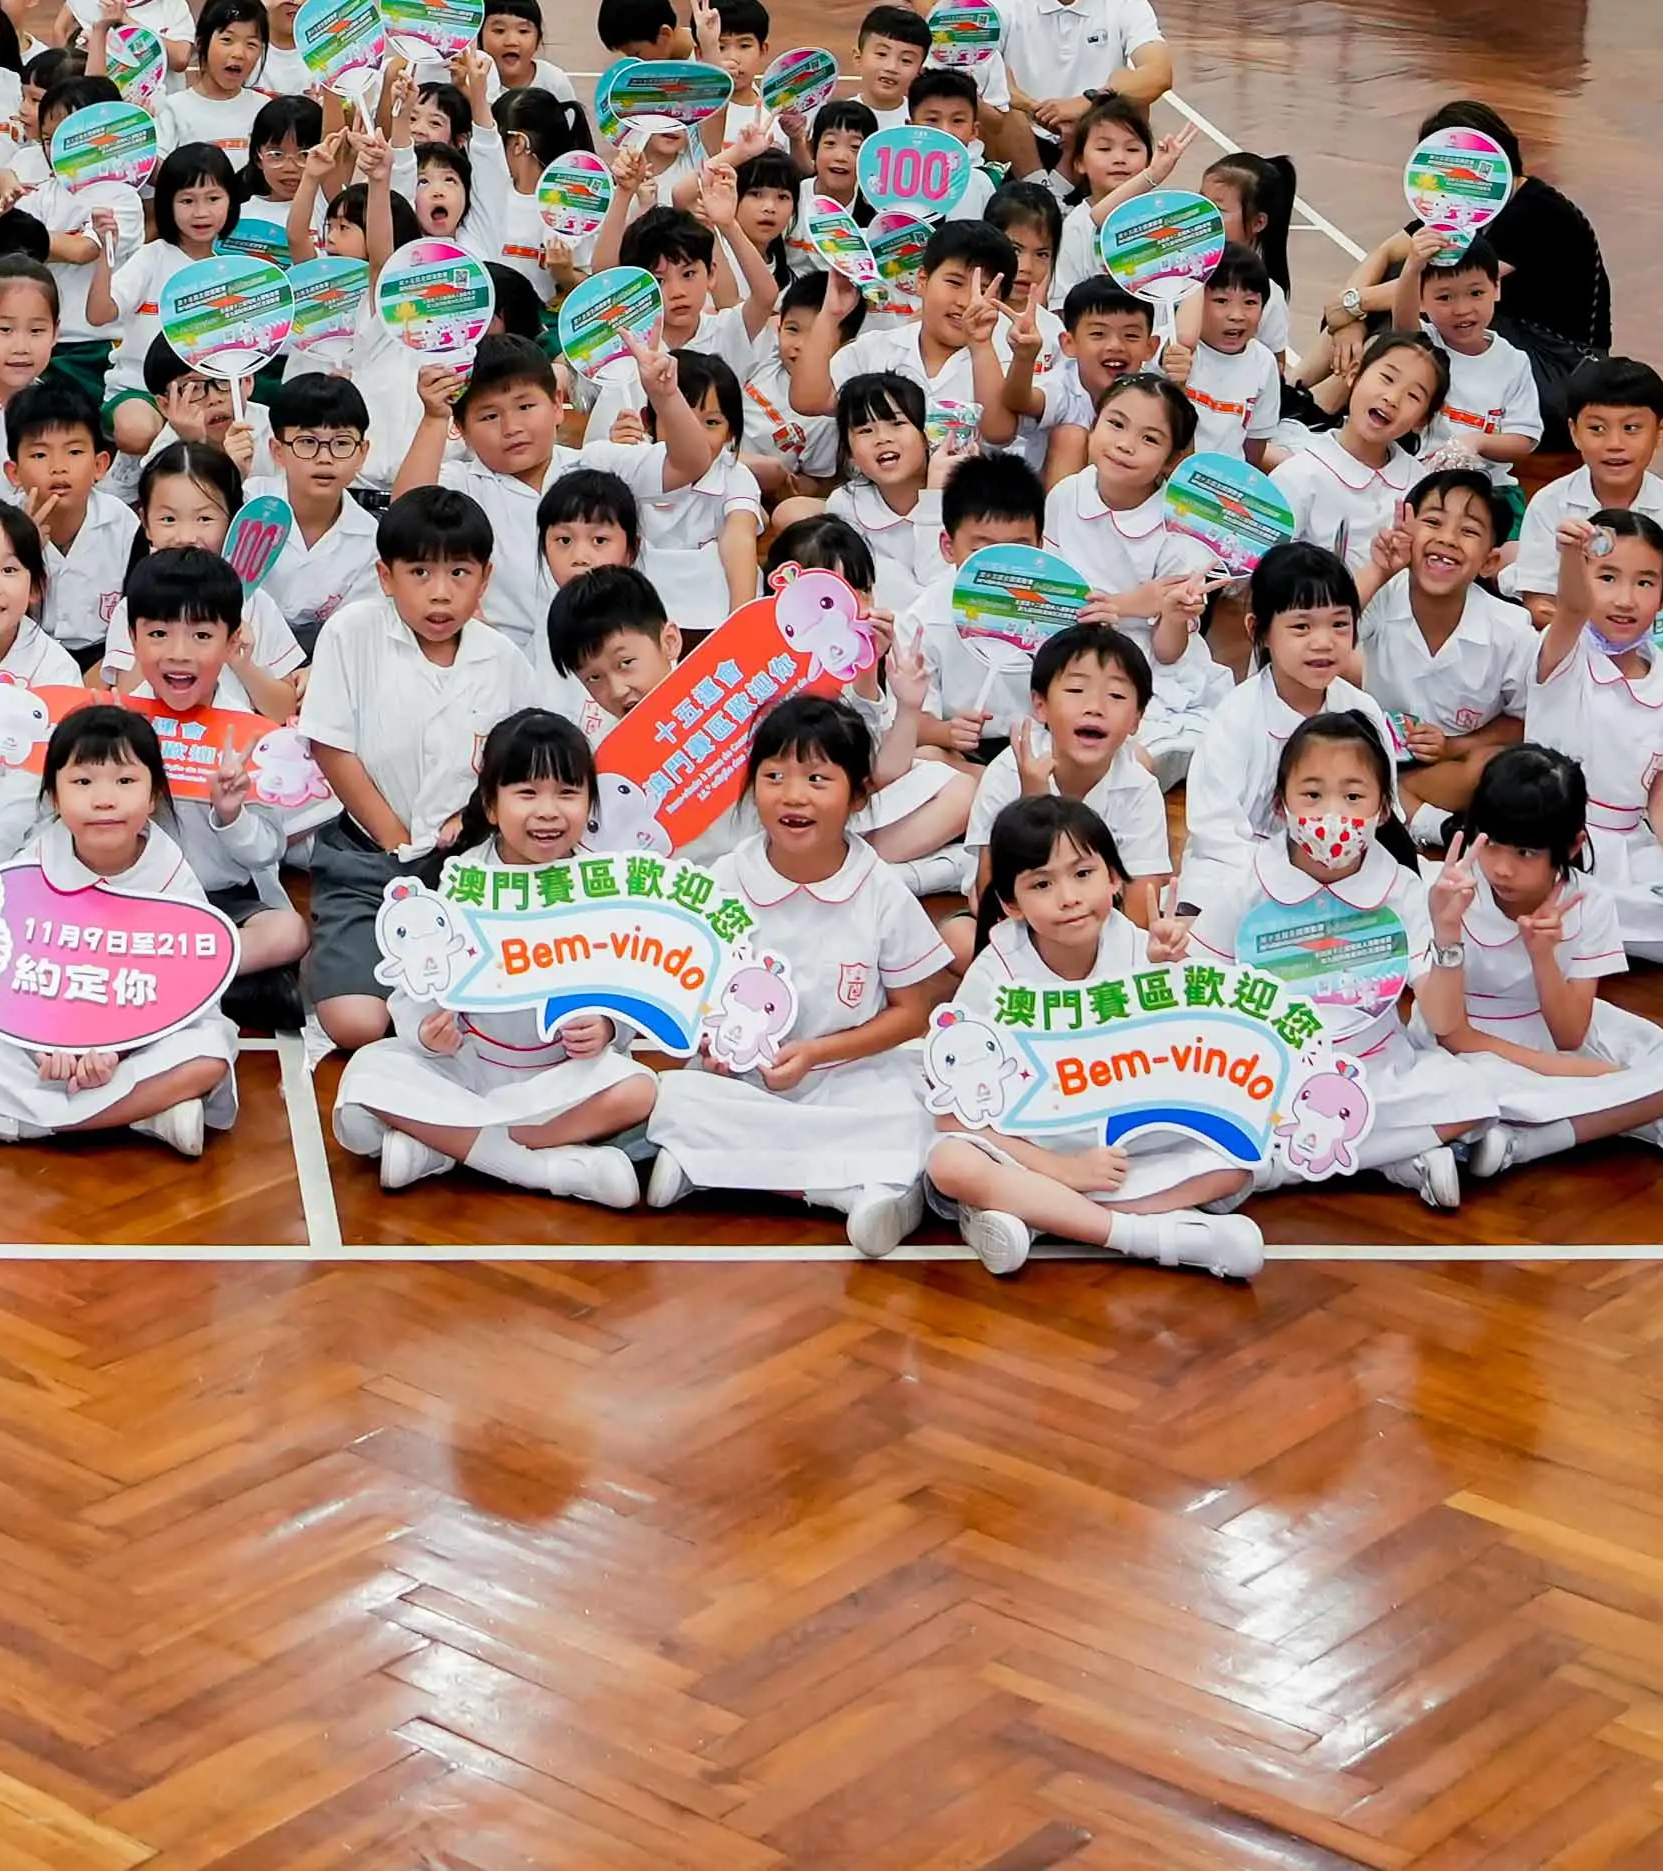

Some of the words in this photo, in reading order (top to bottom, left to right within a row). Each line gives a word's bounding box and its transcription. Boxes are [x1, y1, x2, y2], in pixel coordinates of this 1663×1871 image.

[876, 146, 950, 201] 100
[230, 517, 279, 583] 100
[654, 658, 744, 744] 十五運會
[443, 855, 754, 945] 澳門賽區歡迎您
[24, 916, 217, 959] 11月9日至21日
[501, 925, 706, 992] Bem-vindo
[11, 952, 158, 1007] 約定你
[993, 965, 1324, 1051] 澳門賽區歡迎您
[1055, 1036, 1274, 1101] Bem-vindo
